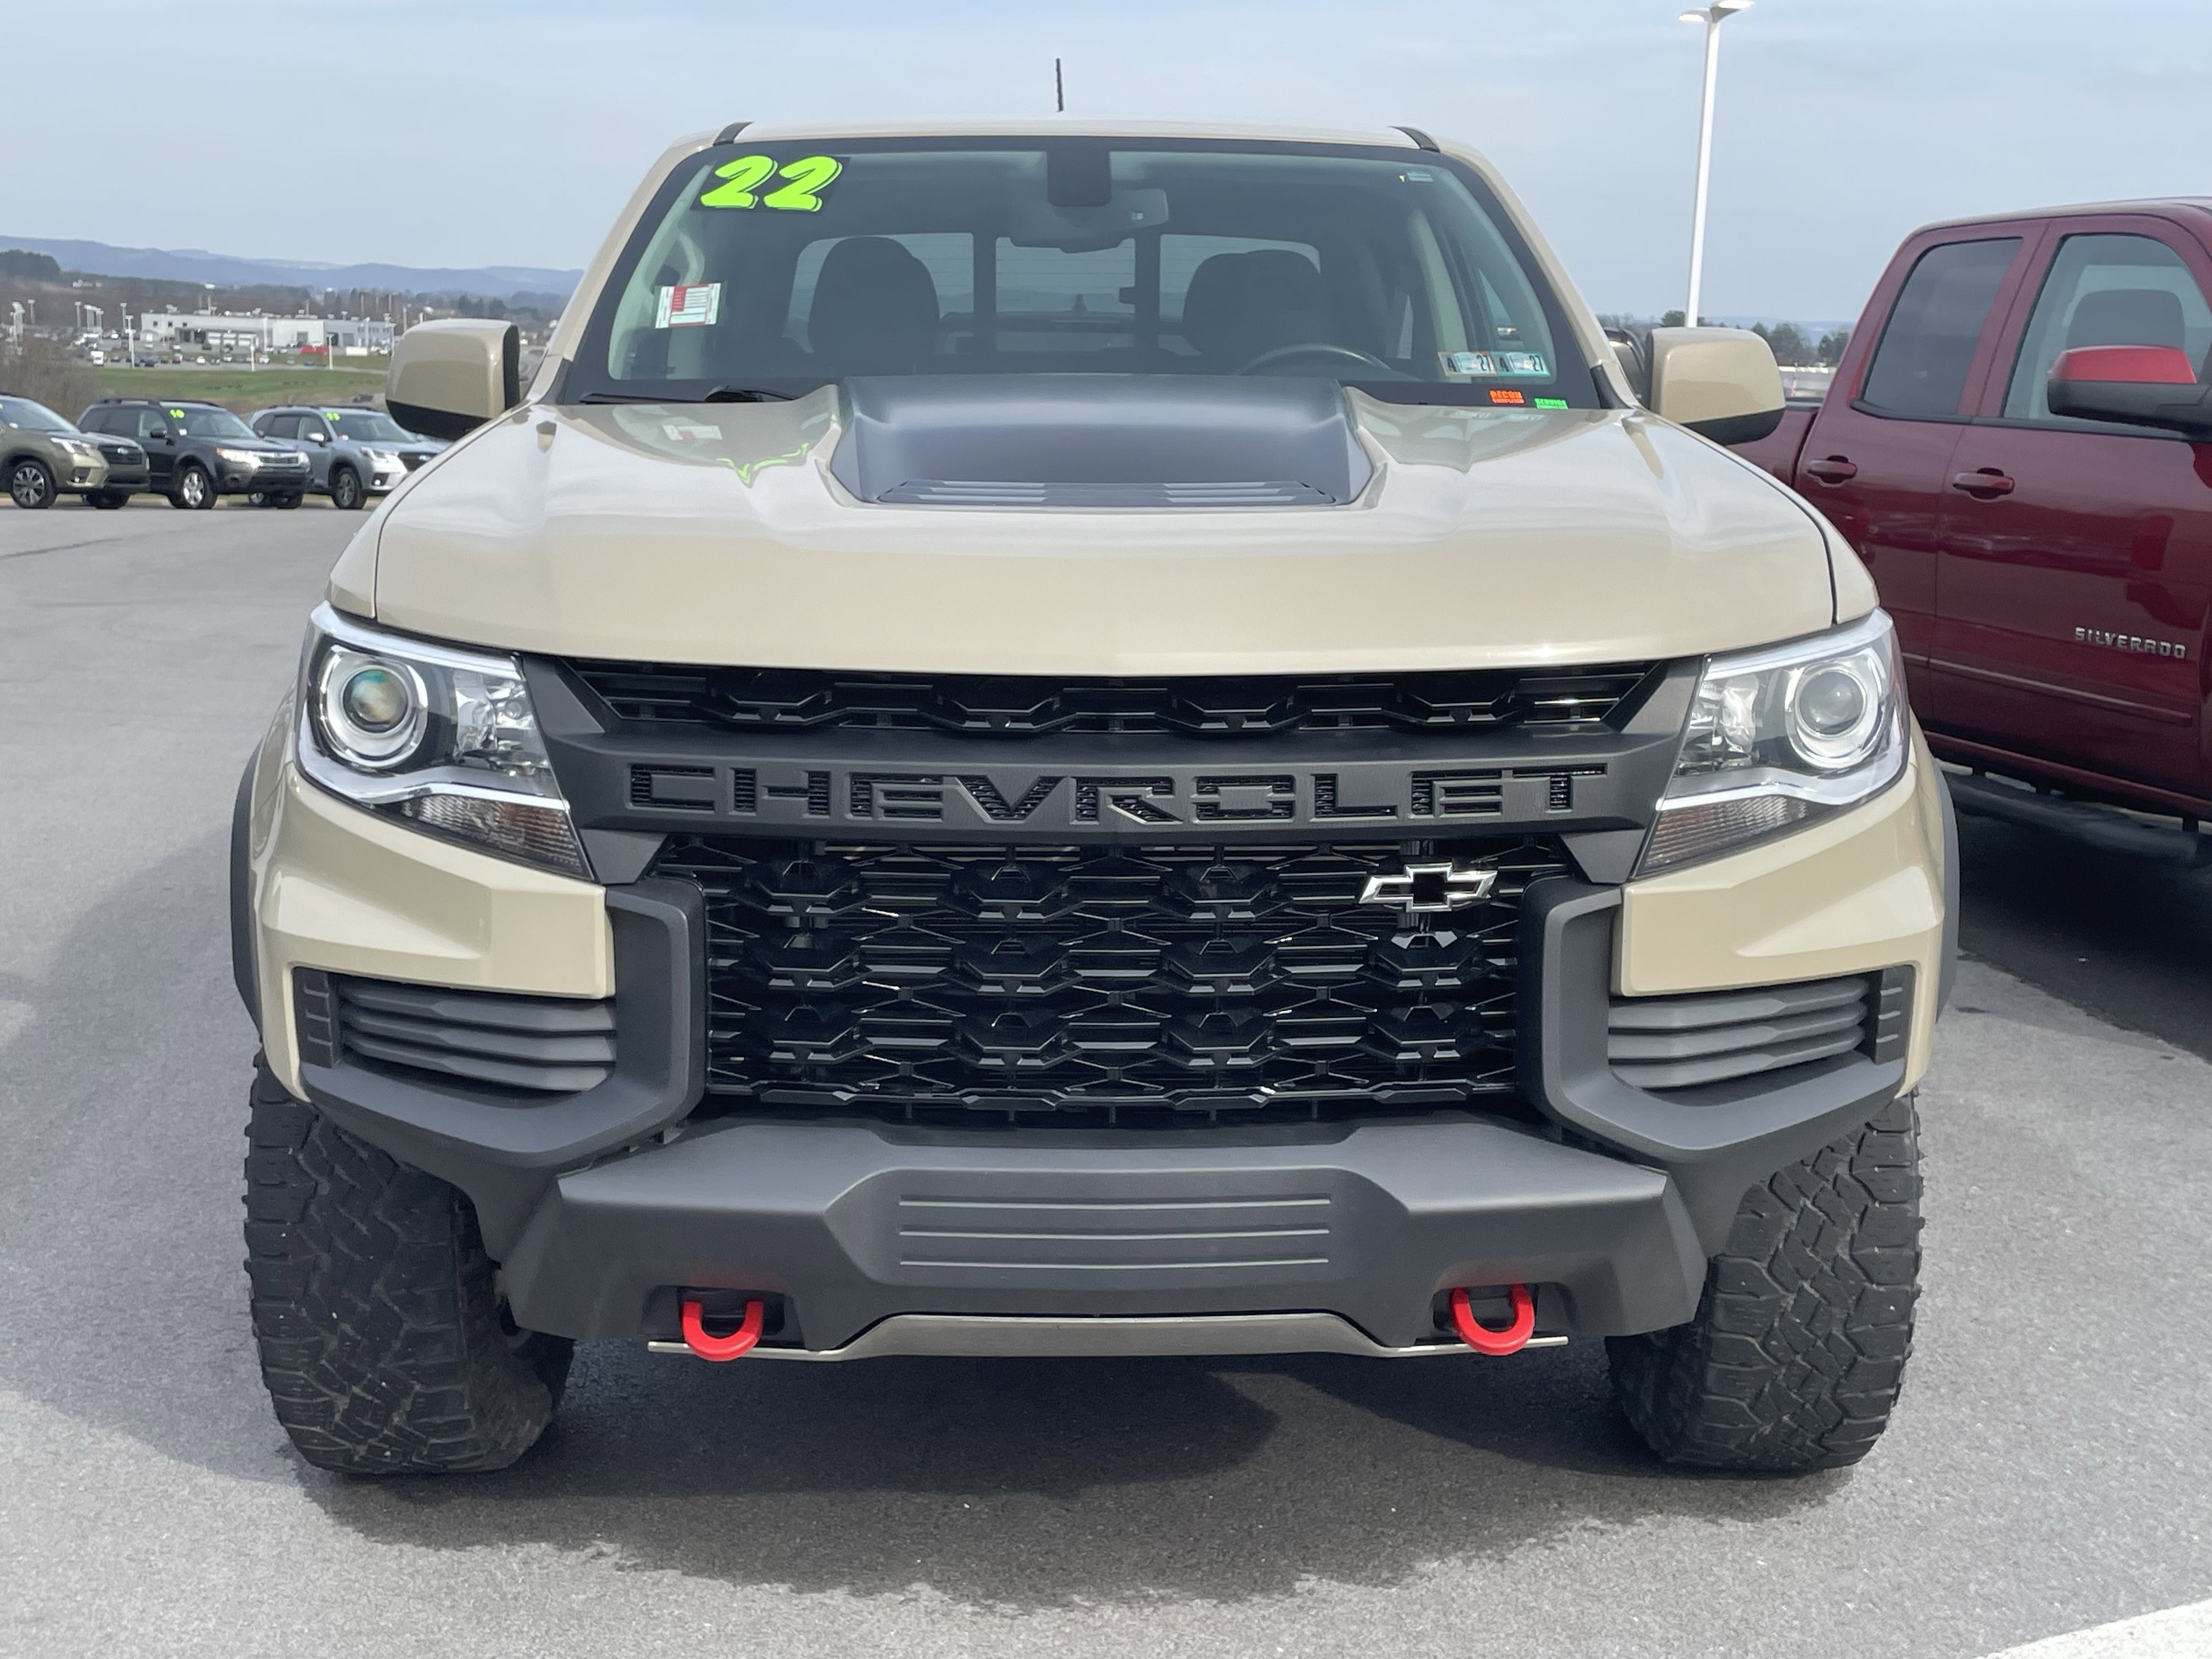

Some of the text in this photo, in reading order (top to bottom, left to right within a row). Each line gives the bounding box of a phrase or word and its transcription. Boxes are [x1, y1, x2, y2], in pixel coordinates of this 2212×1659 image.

[700, 155, 843, 212] 22
[2075, 627, 2186, 659] SILVERADO
[628, 763, 1609, 825] CHEVROLET
